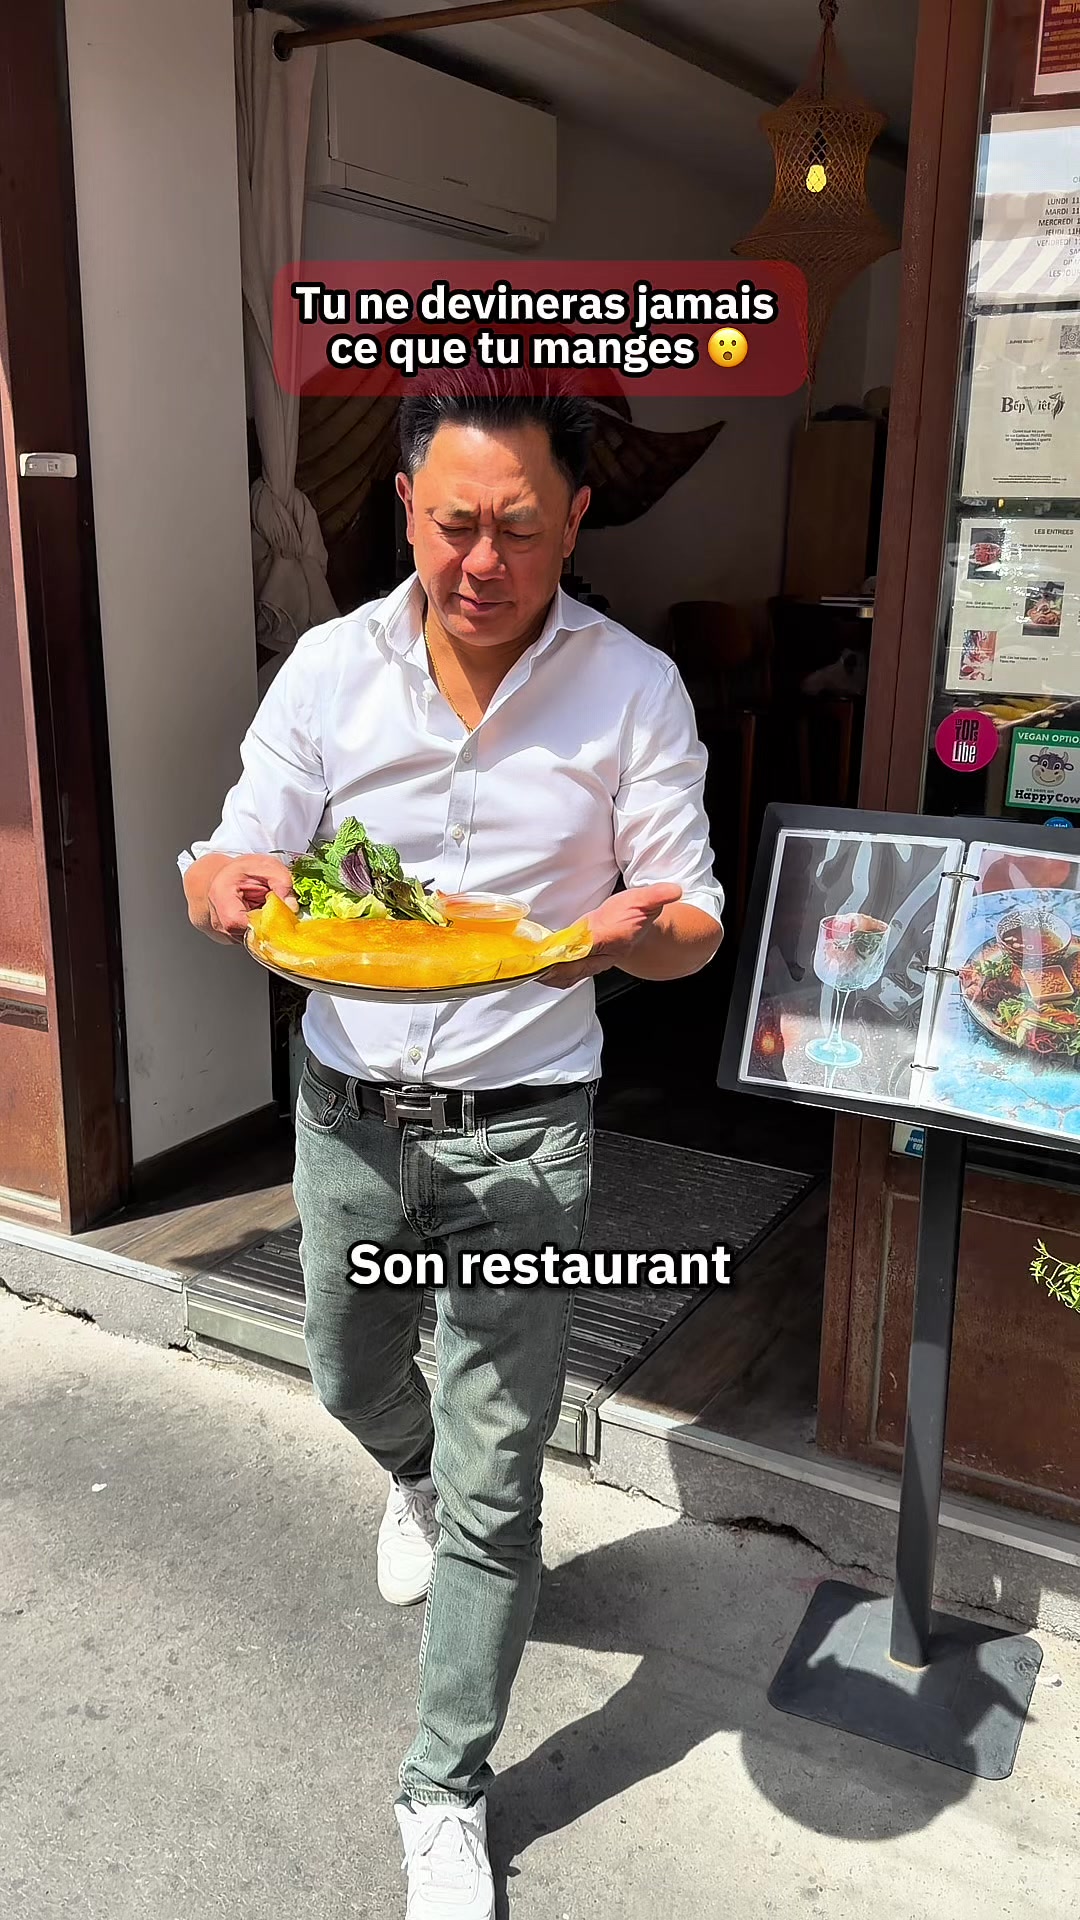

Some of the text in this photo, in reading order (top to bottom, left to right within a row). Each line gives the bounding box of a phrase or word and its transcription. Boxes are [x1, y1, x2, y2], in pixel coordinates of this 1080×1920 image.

[1047, 197, 1068, 205] LUNDI
[1038, 217, 1074, 227] MERCREDI
[1017, 731, 1080, 744] VEGAN OPTIO
[951, 740, 977, 763] Libé
